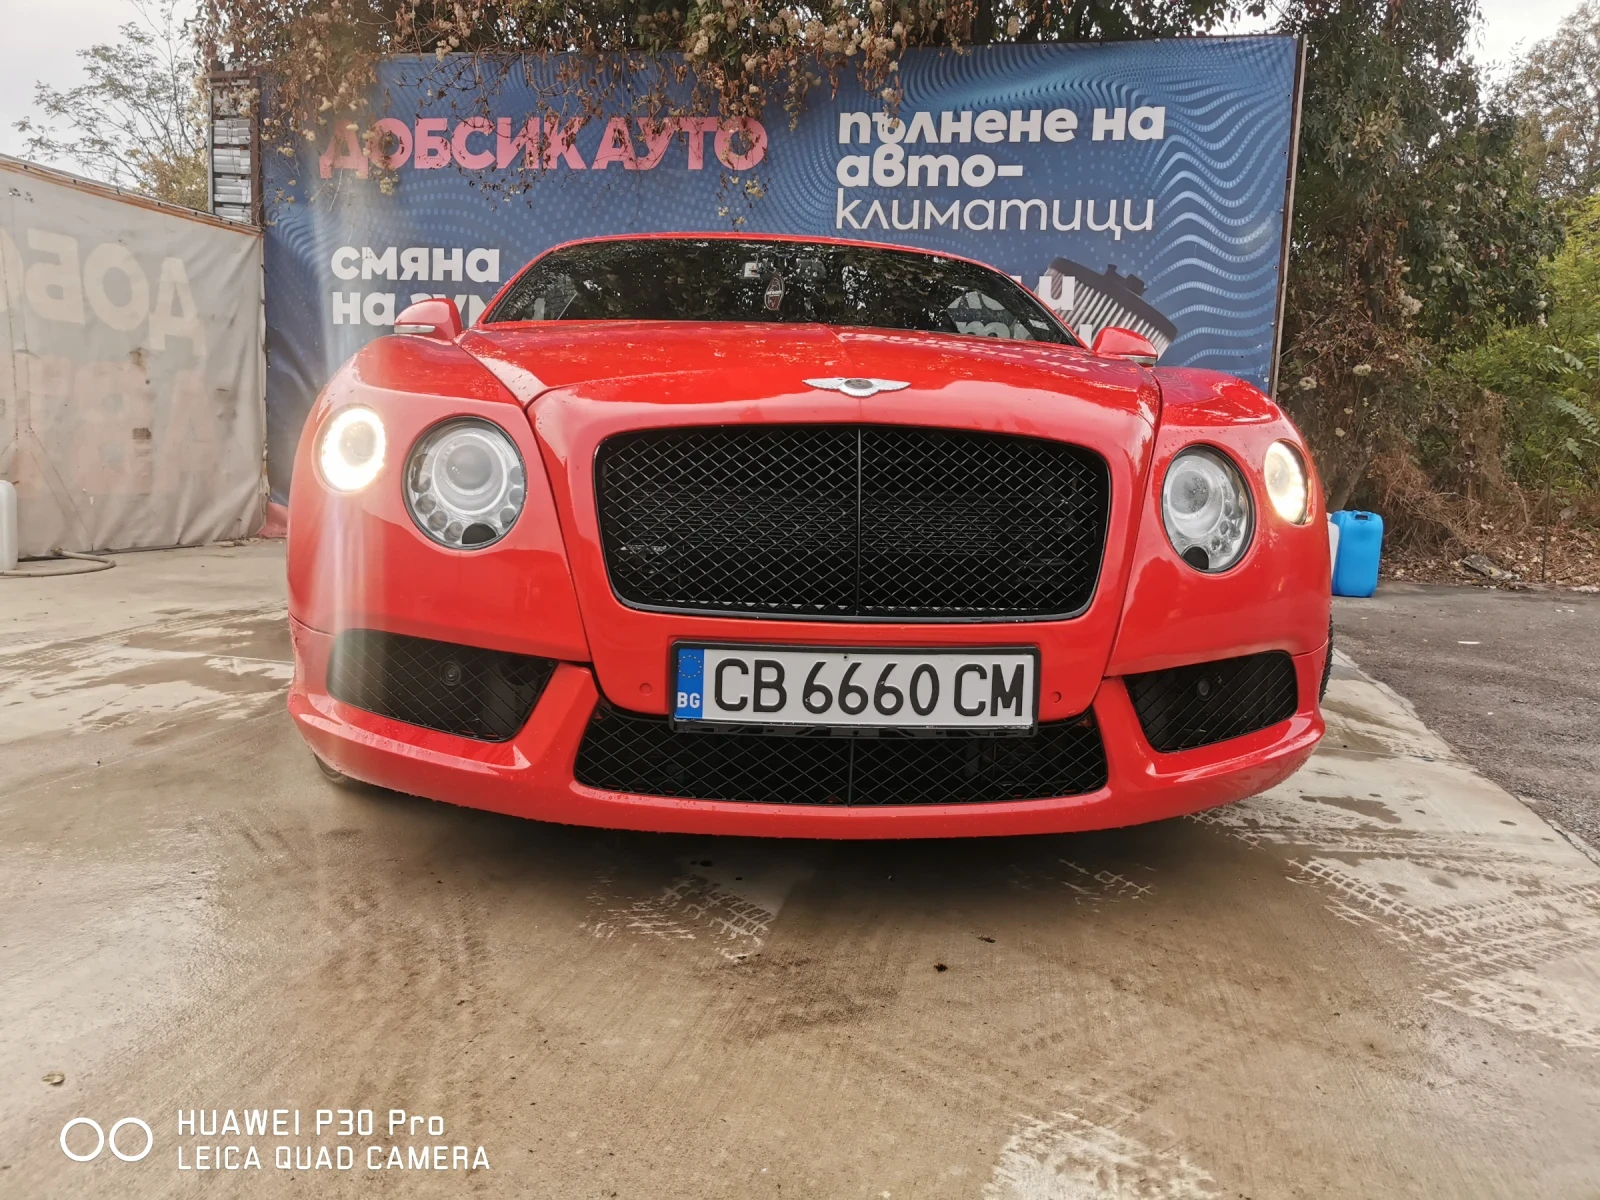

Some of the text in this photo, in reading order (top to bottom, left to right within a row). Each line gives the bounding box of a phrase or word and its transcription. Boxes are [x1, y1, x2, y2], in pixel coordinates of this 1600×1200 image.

[838, 105, 1166, 145] пълнене на
[319, 116, 768, 180] ДОБСИК АУТО
[836, 143, 1024, 187] авто-
[836, 187, 1154, 240] климатици
[331, 246, 500, 283] смяна
[332, 291, 396, 326] на
[677, 658, 1025, 717] BG CB 6660 CM
